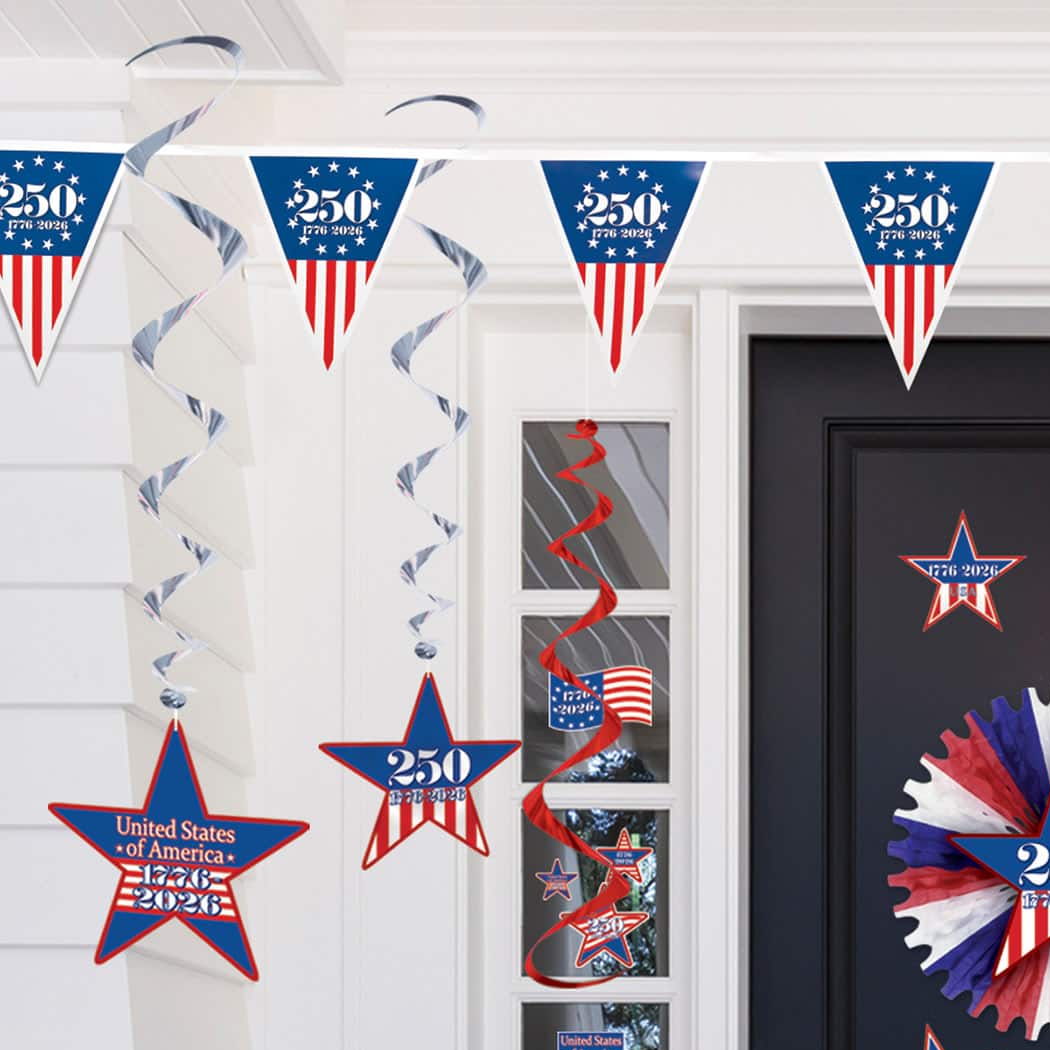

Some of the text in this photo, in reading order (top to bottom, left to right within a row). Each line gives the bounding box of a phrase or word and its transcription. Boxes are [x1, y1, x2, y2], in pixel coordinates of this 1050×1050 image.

[0, 183, 77, 218] 250
[294, 188, 372, 223] 250
[583, 192, 660, 226] 250
[870, 193, 949, 228] 250
[387, 746, 471, 787] 250
[116, 815, 236, 844] United States
[126, 837, 225, 864] of America
[132, 887, 222, 916] 2026
[560, 1034, 622, 1047] United States
